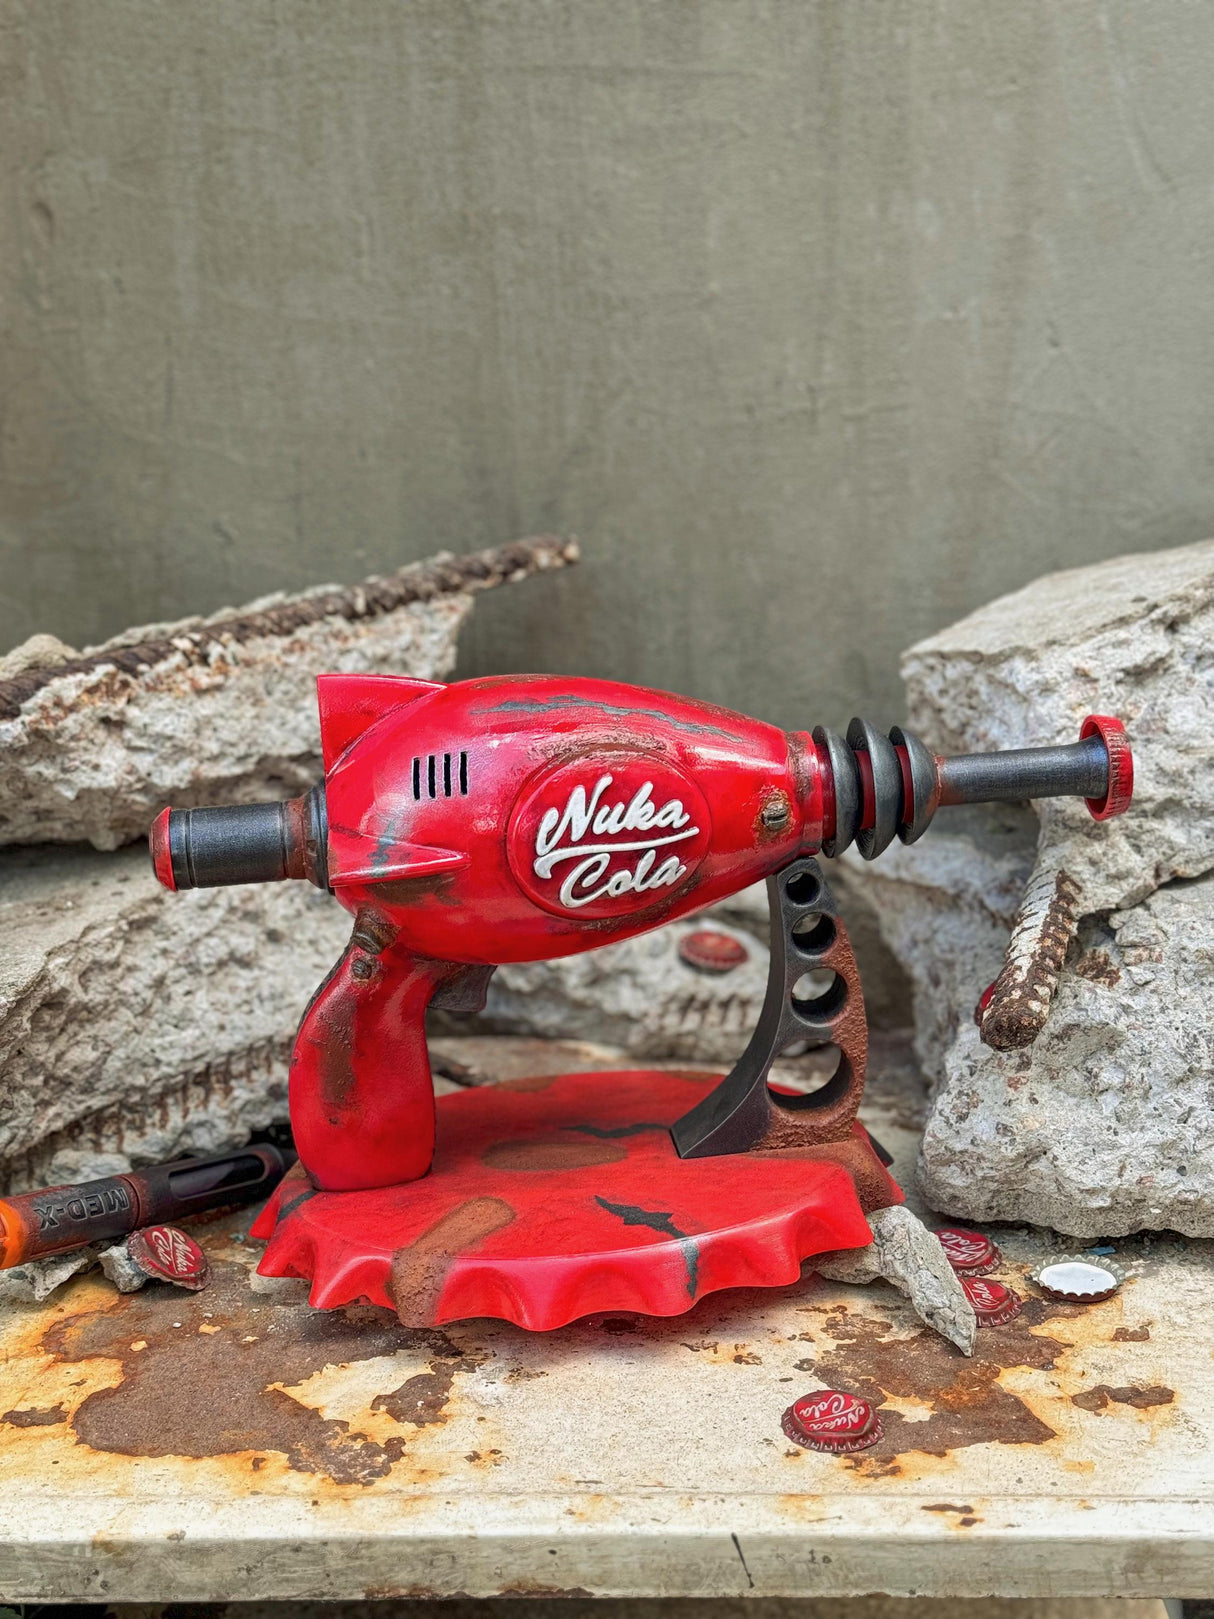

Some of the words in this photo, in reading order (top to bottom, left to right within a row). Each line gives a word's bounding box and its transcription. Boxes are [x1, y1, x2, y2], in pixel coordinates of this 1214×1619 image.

[535, 772, 691, 856] Nuka
[559, 849, 687, 909] Cola
[33, 1186, 130, 1231] MED-X
[171, 1229, 195, 1272] Nuka
[940, 1232, 986, 1251] Cola
[972, 1281, 1000, 1306] Cola
[799, 1393, 846, 1419] Cola
[809, 1405, 866, 1432] Nuka
